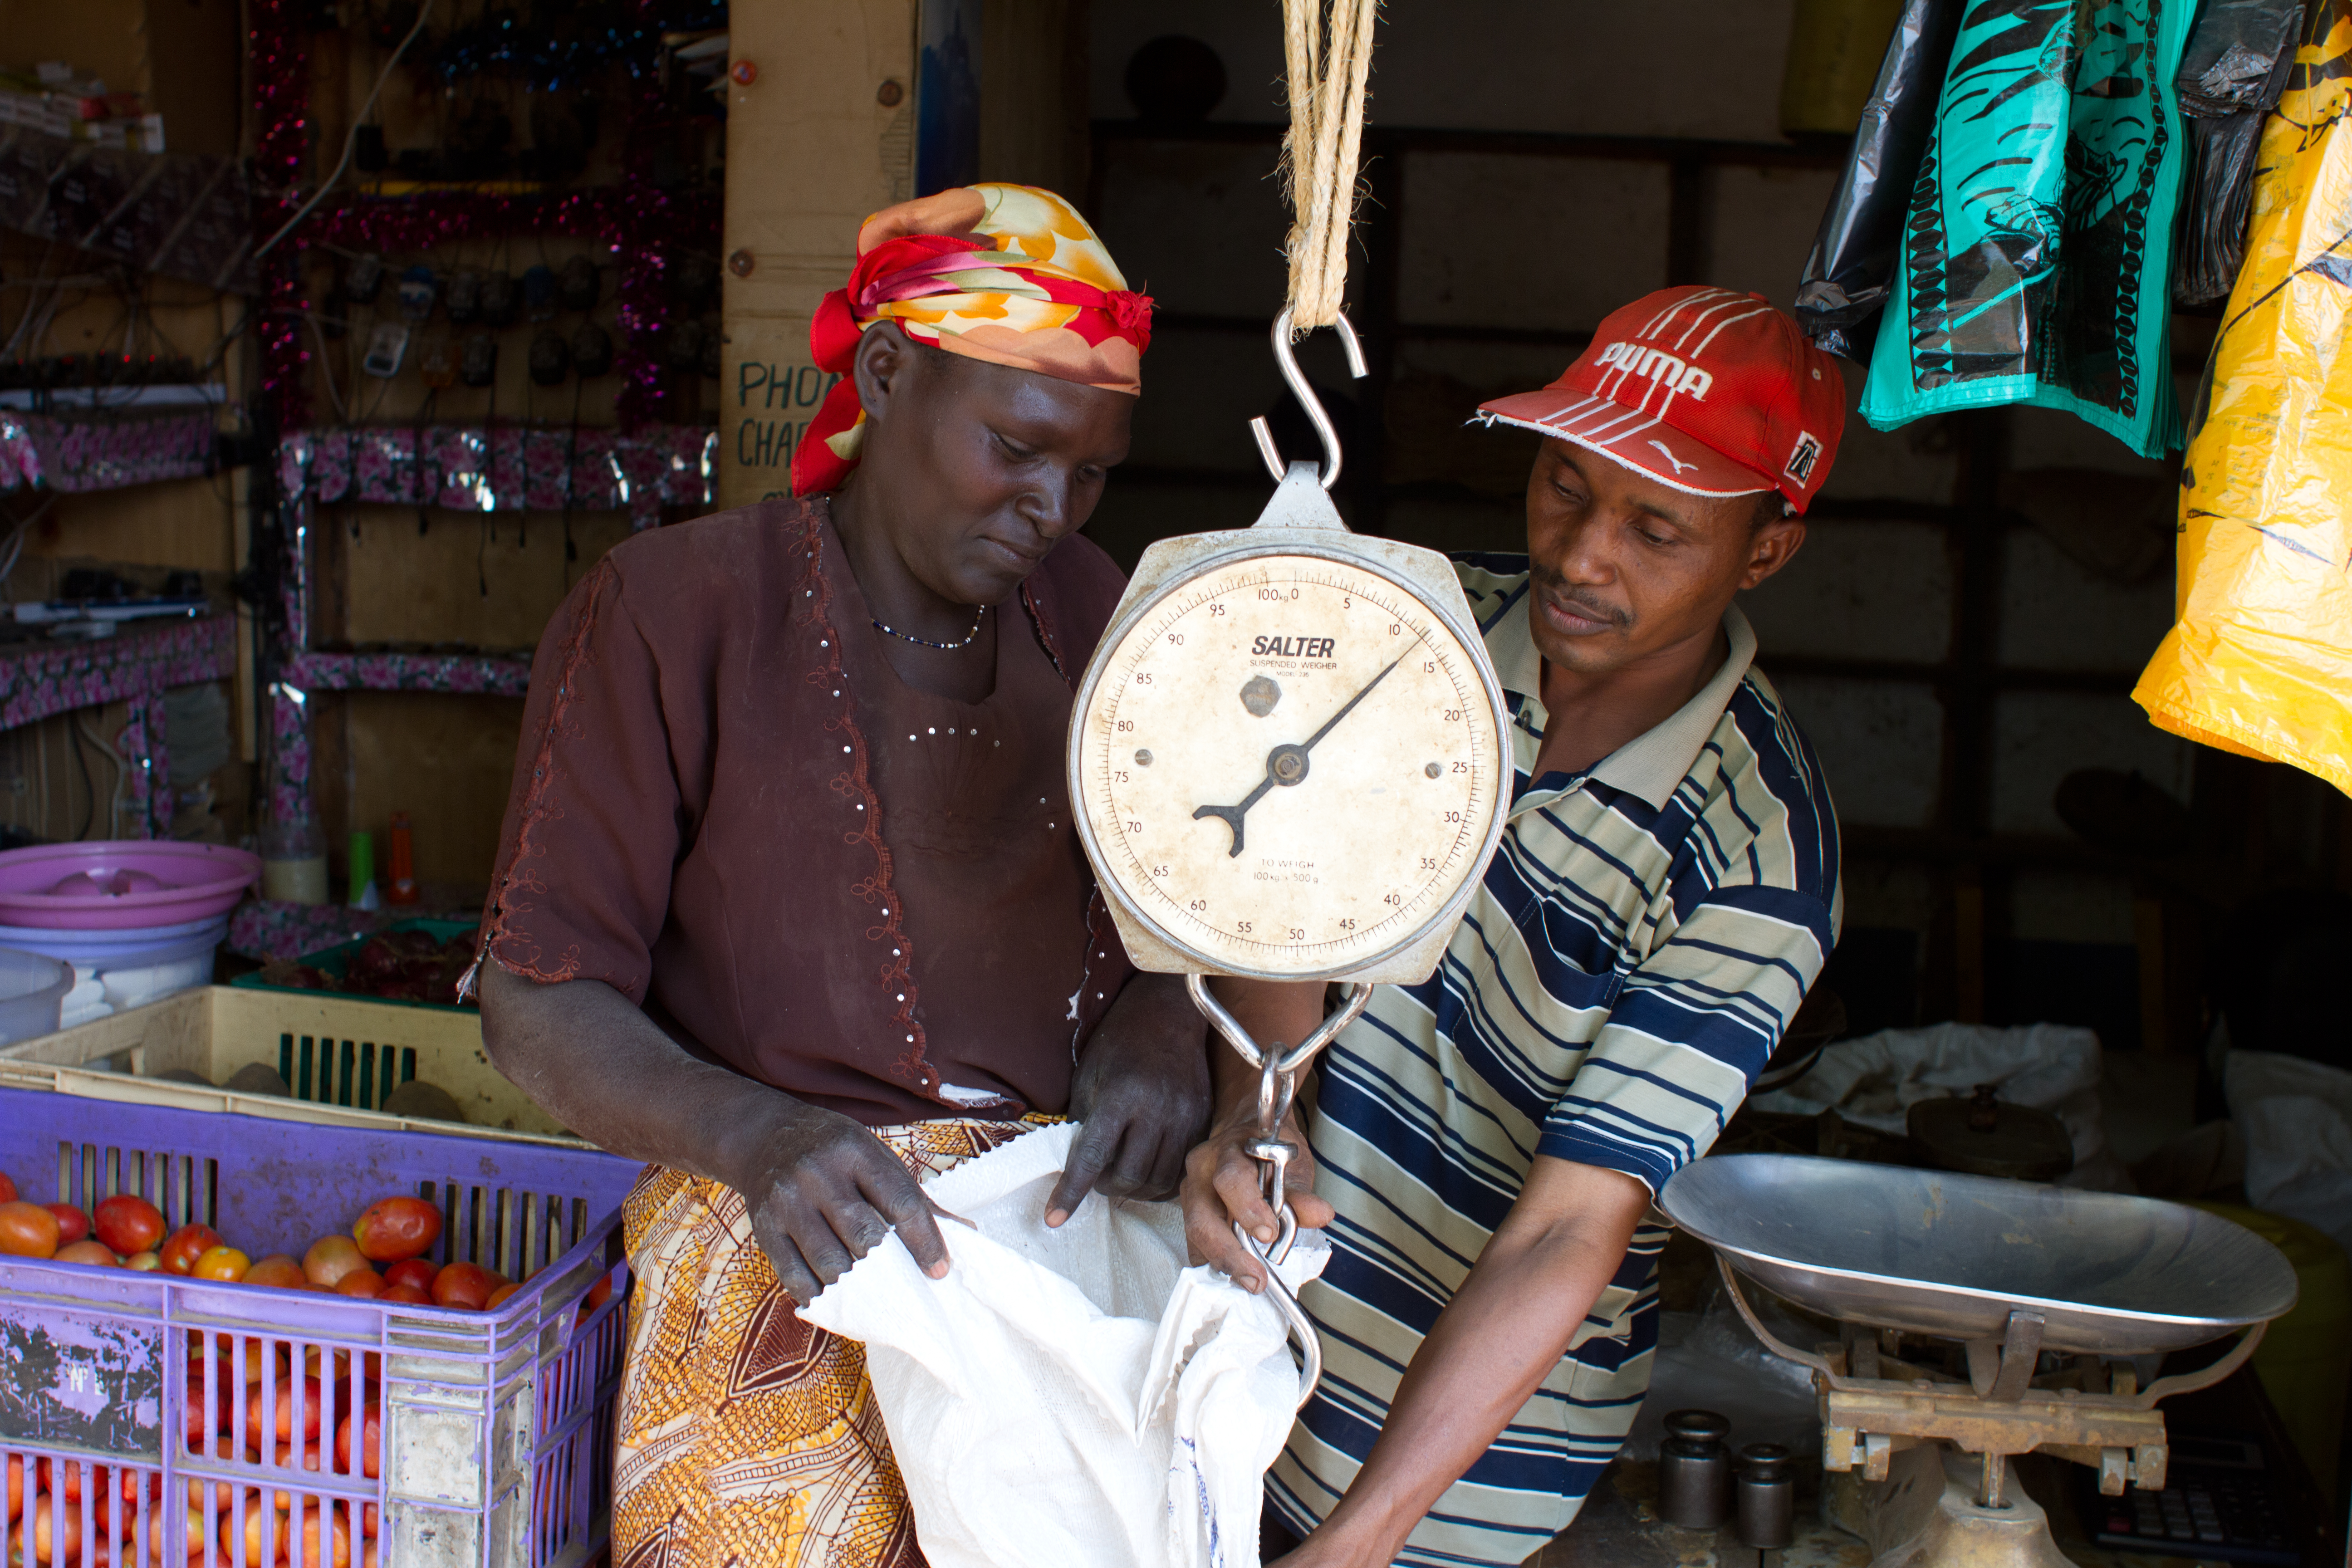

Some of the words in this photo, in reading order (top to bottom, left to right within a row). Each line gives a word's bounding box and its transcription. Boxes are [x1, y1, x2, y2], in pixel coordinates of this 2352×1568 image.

[1594, 341, 1714, 402] PUMA
[1291, 588, 1299, 600] 0
[1343, 598, 1350, 609] 5
[1210, 604, 1225, 616] 95
[1389, 624, 1400, 636] 10
[1168, 634, 1184, 645] 90
[1252, 636, 1335, 658] SALTER
[1250, 660, 1296, 668] SUSPENDED
[1424, 662, 1435, 673] 15
[1137, 673, 1152, 684] 85
[1444, 709, 1460, 721] 20
[1118, 720, 1134, 732] 80
[1452, 762, 1467, 773] 25
[1114, 771, 1128, 783] 75
[1444, 811, 1460, 823] 30
[1127, 821, 1142, 833] 70
[1421, 858, 1436, 870] 35
[1154, 866, 1169, 877] 65
[1191, 900, 1206, 911] 60
[1384, 894, 1400, 906] 40
[1237, 921, 1252, 933] 55
[1339, 919, 1355, 930] 45
[1289, 929, 1304, 940] 50
